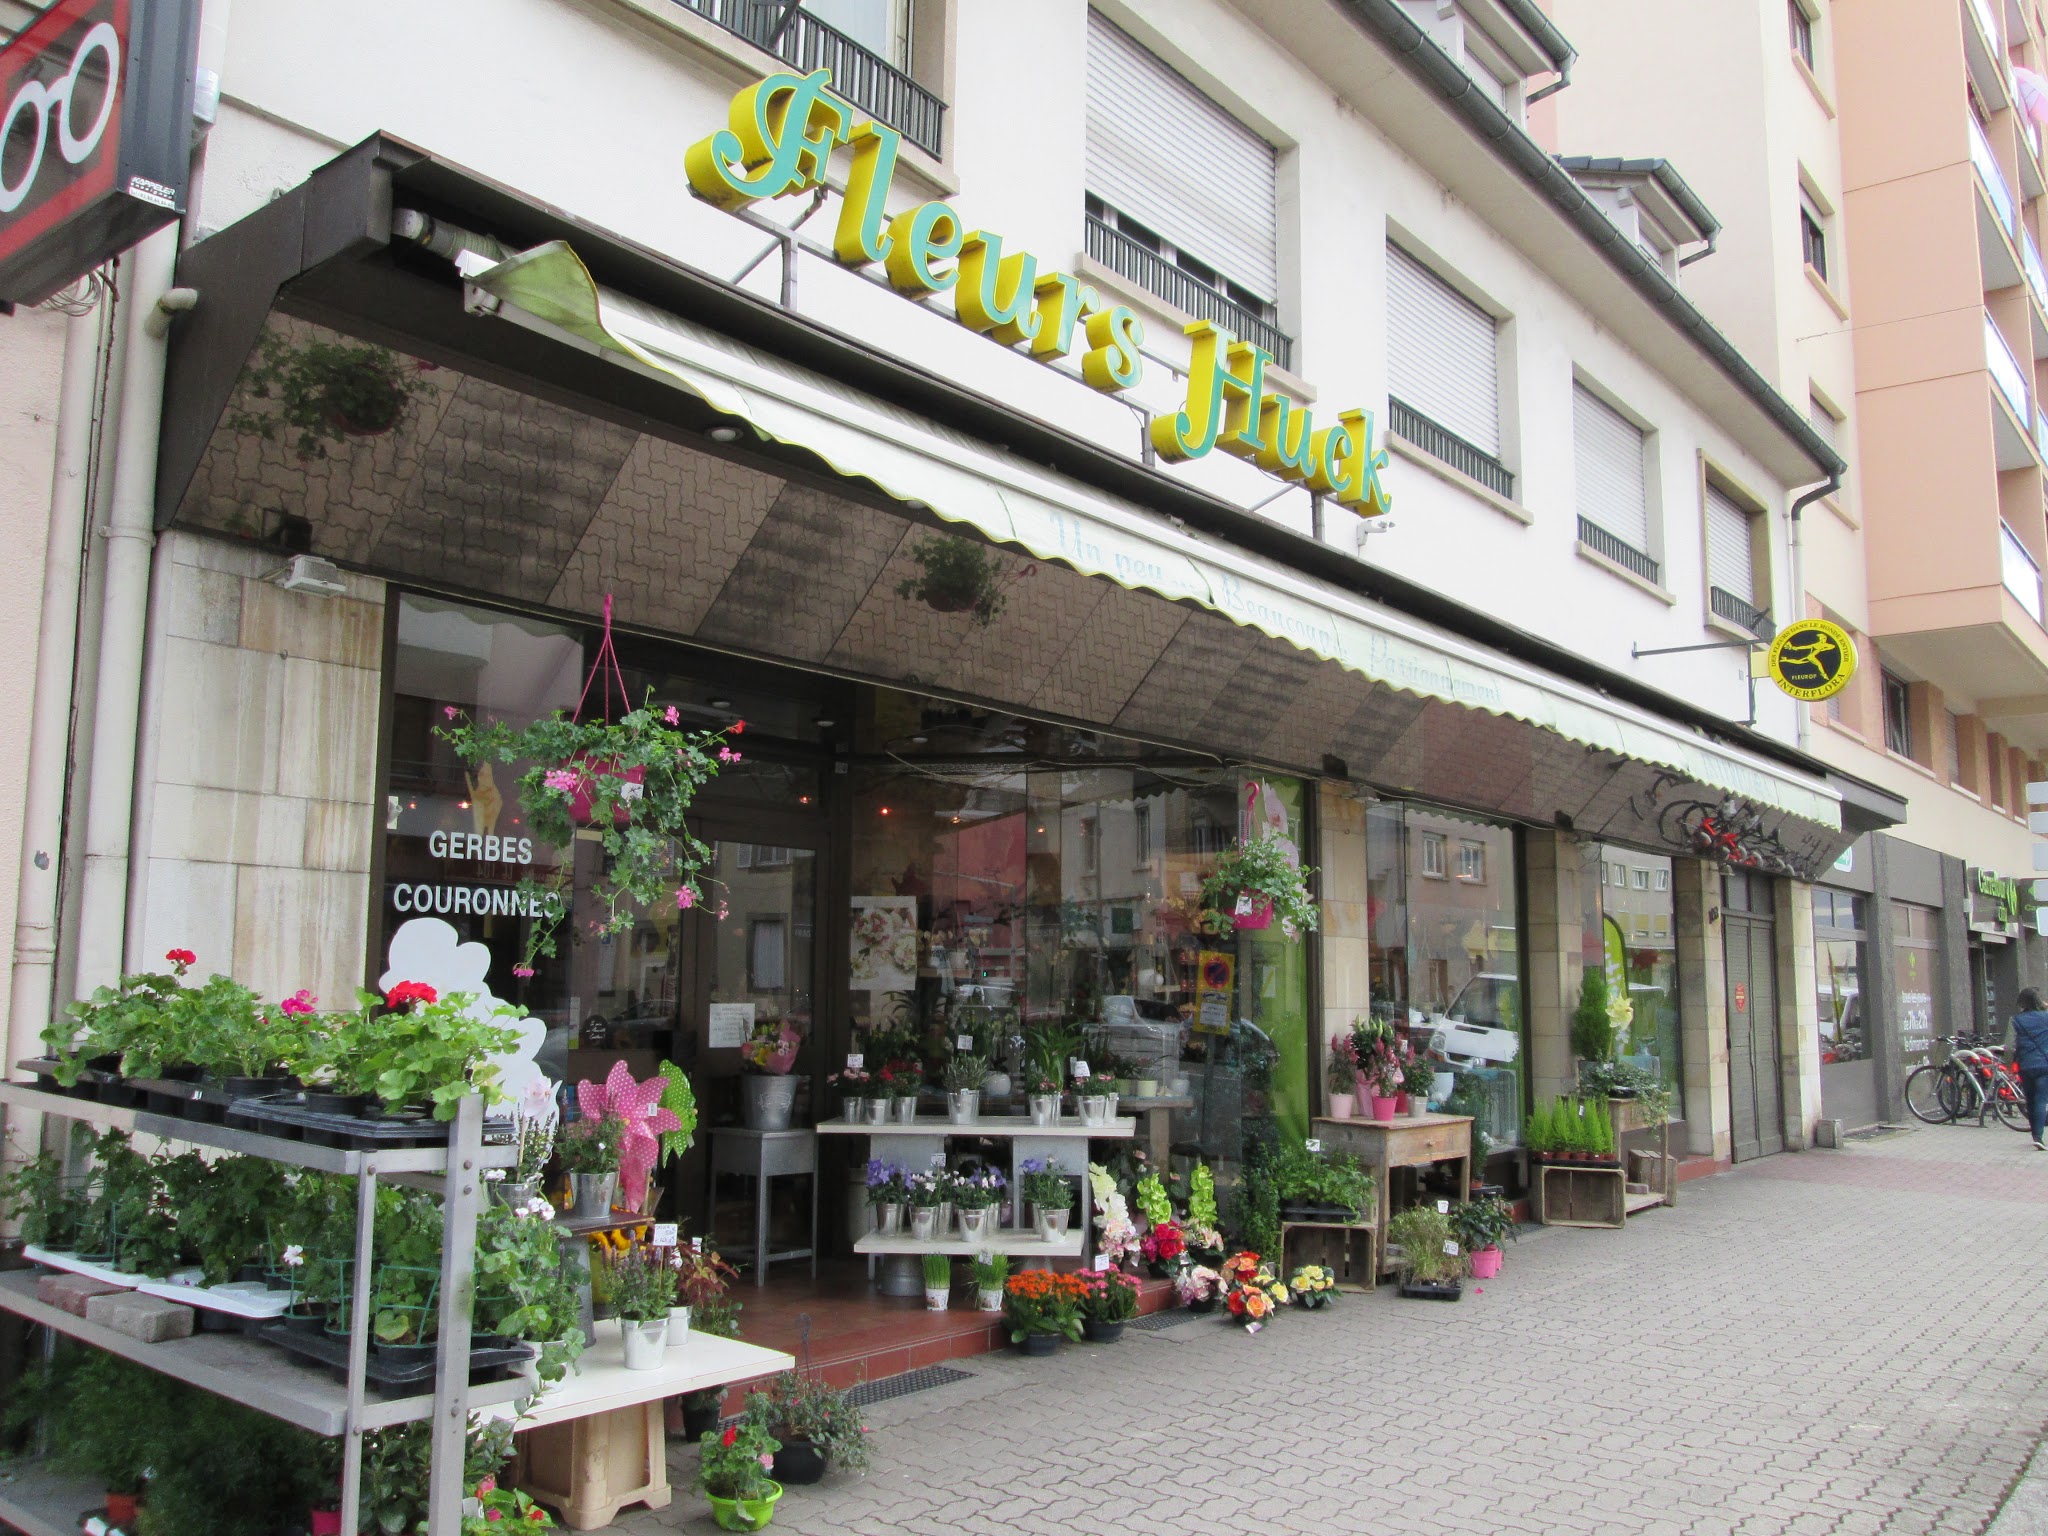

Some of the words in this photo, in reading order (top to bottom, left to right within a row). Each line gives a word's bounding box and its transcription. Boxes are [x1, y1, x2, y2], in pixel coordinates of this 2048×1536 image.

[685, 68, 1144, 393] Fleurs
[1150, 318, 1392, 518] Huck
[1773, 631, 1791, 653] FLEURS
[1790, 623, 1809, 633] DANS
[1820, 624, 1842, 640] MONDE
[1840, 640, 1849, 662] ENTIER
[1777, 674, 1845, 697] INTERFLORA
[429, 830, 533, 865] GERBES
